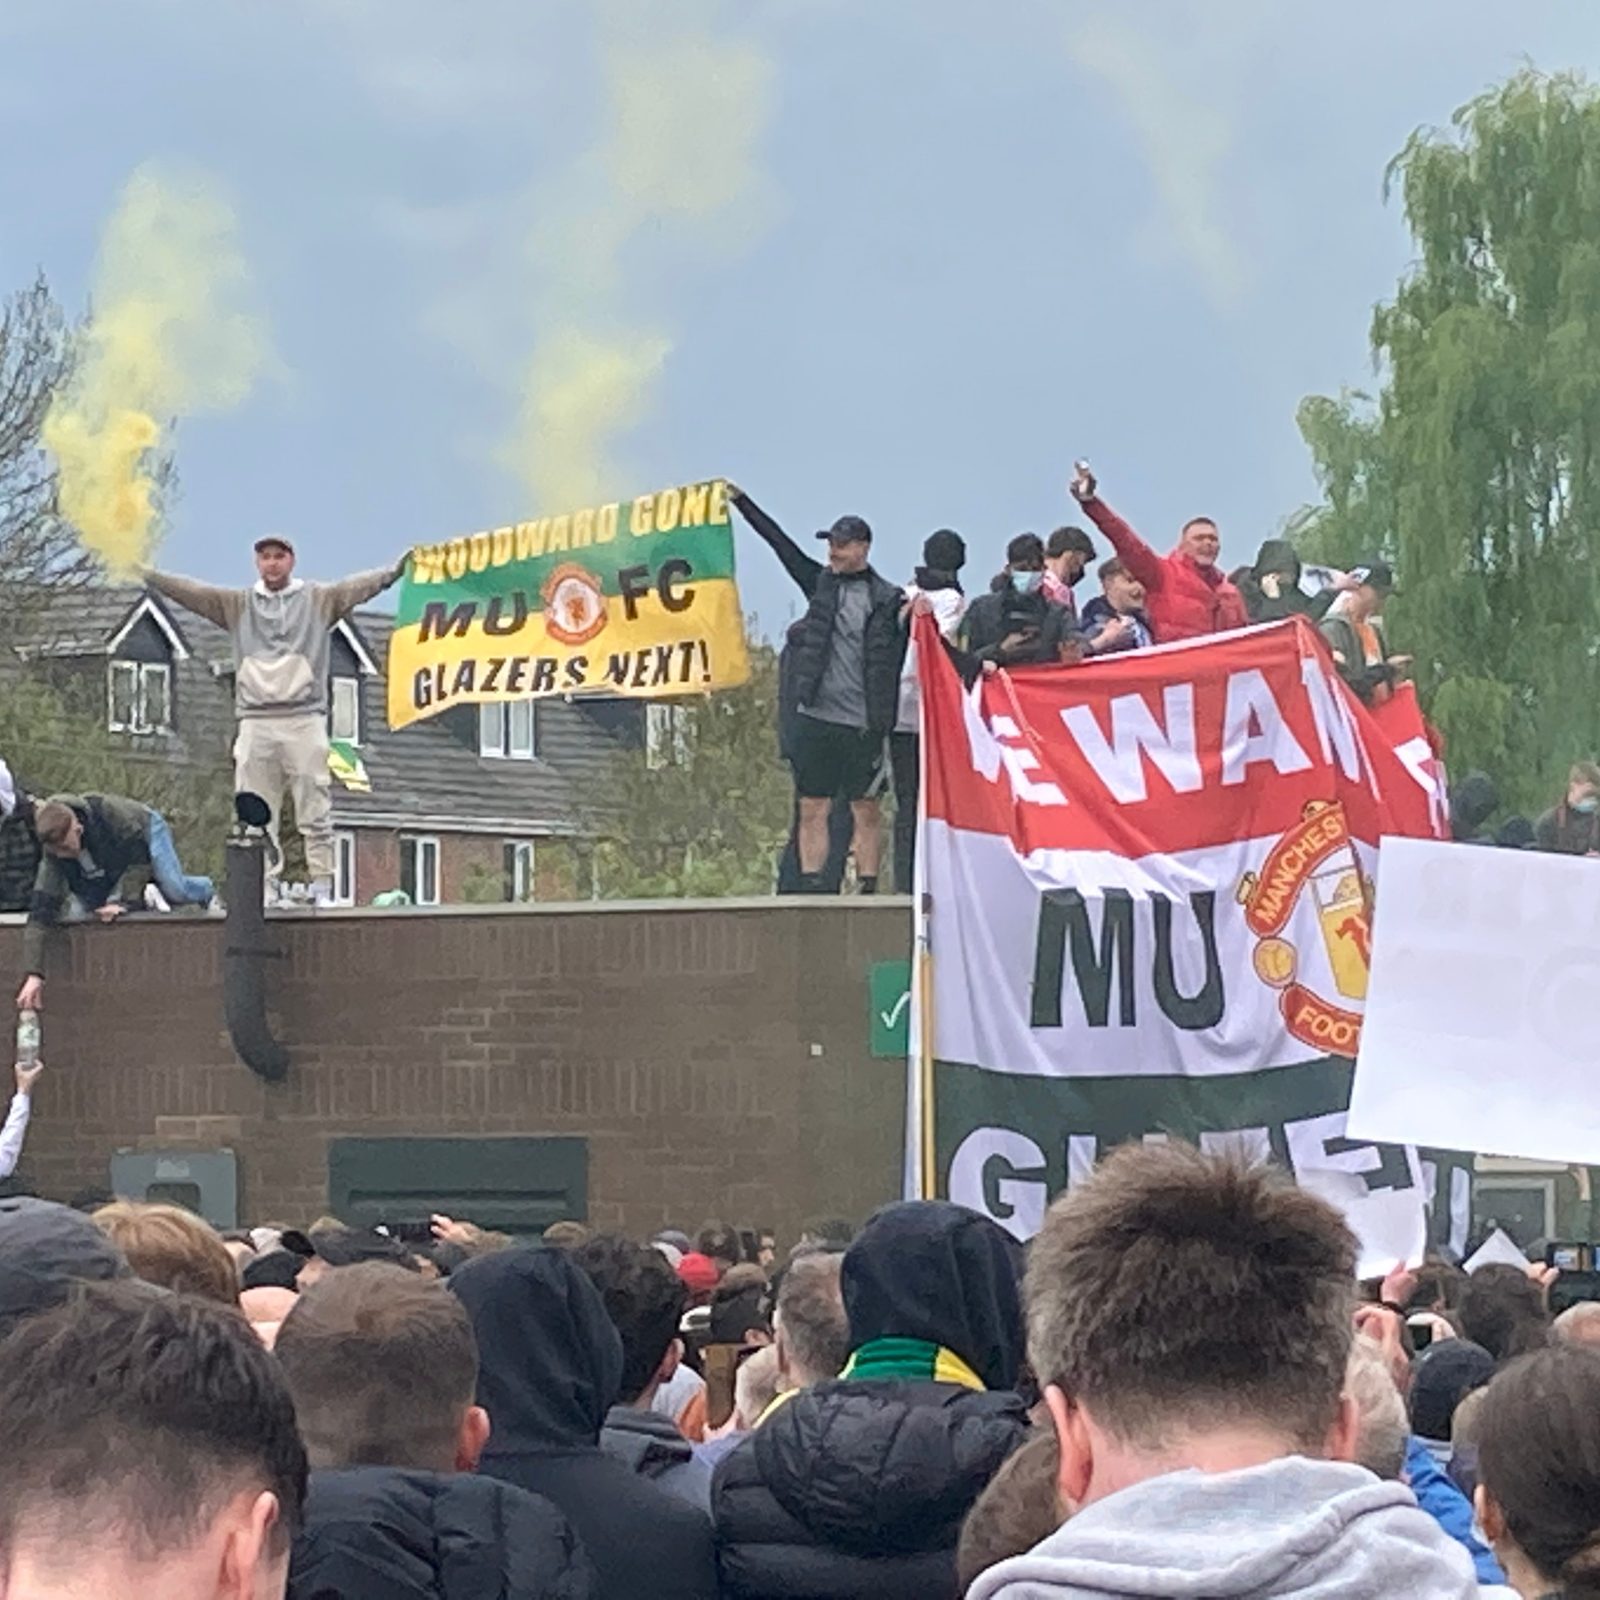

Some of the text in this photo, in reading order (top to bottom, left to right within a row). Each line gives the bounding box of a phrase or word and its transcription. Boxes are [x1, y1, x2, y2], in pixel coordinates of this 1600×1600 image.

[630, 482, 727, 536] GONE
[417, 558, 694, 643] MU FC
[413, 640, 711, 709] GLAZERS NEXT!
[1255, 815, 1342, 924] MANCHES
[1030, 888, 1225, 1031] MU
